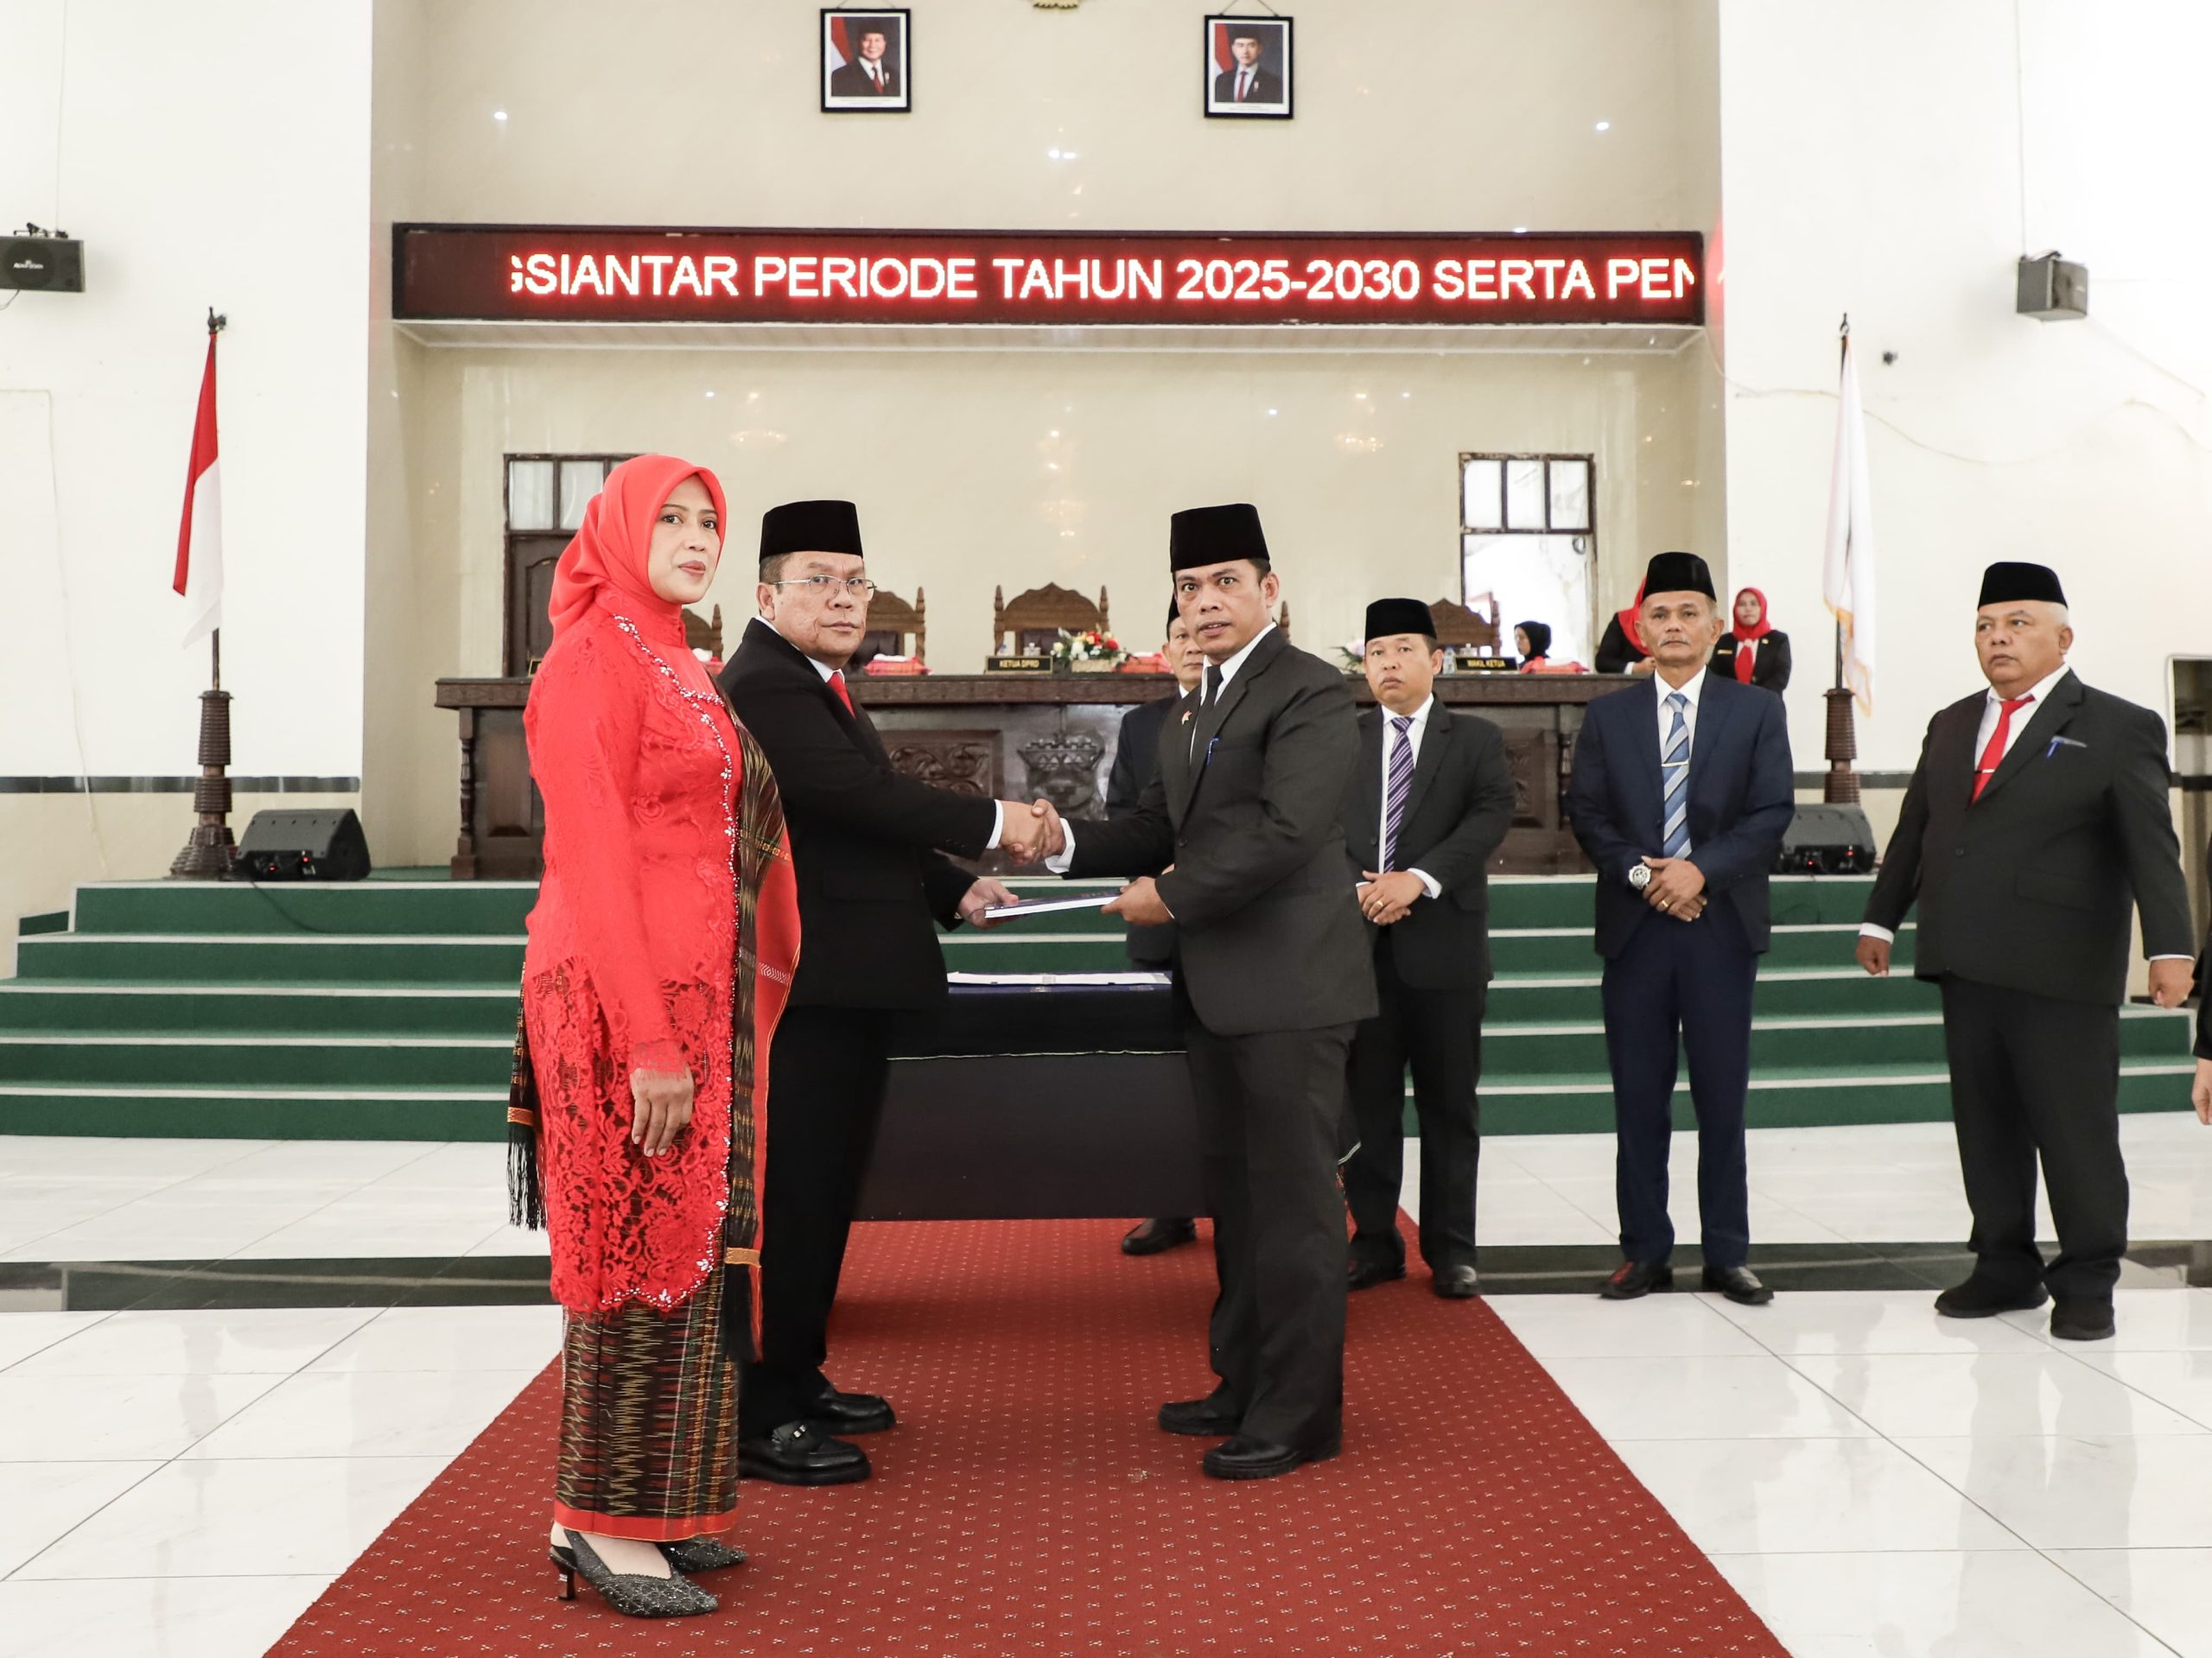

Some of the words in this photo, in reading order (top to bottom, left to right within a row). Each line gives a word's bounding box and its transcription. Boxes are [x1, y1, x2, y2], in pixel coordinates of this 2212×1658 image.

[754, 256, 978, 298] PERIODE
[992, 258, 1163, 299] TAHUN
[1176, 259, 1421, 300] 2025-2030
[1433, 259, 1597, 300] SERTA
[999, 659, 1020, 668] KETUA
[1485, 659, 1506, 668] KETUA
